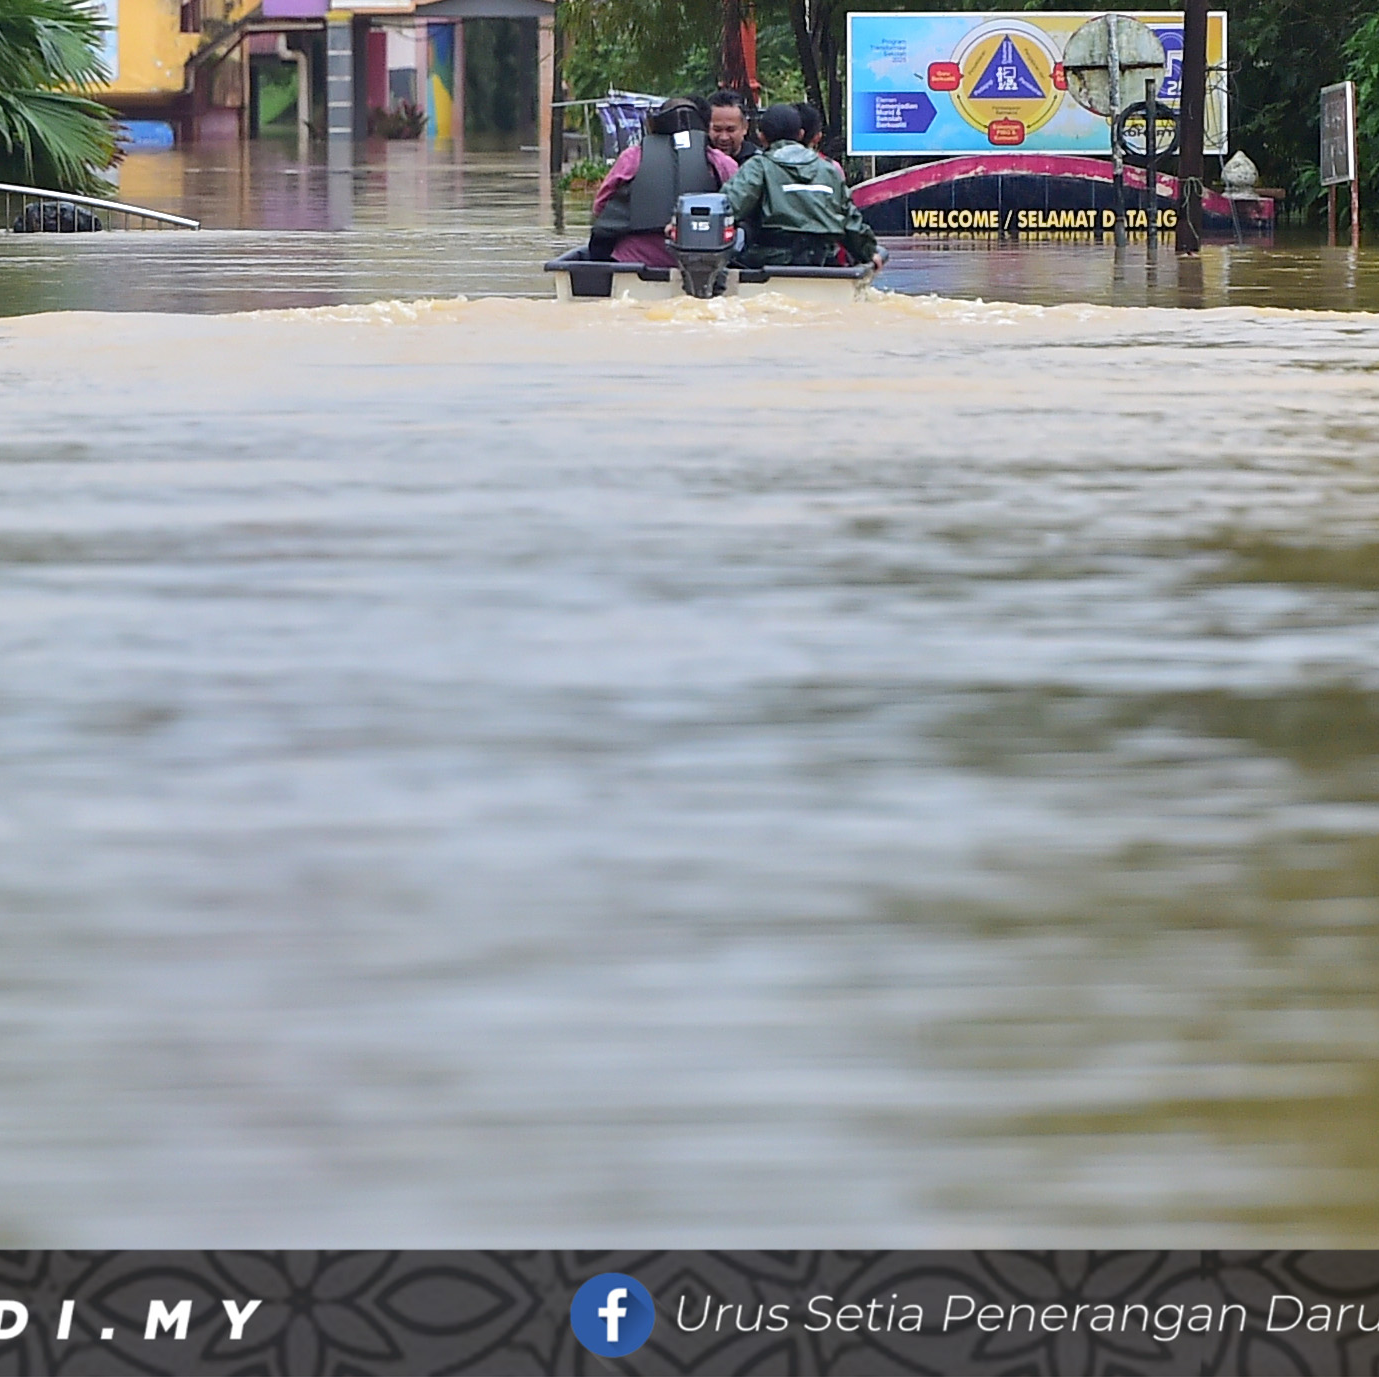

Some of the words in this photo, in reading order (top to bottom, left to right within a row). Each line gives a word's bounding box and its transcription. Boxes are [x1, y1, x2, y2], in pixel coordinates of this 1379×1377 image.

[691, 221, 711, 231] 15
[910, 209, 999, 229] WELCOME
[1003, 209, 1013, 230] /
[1017, 209, 1098, 229] SELAMAT
[1102, 209, 1178, 229] DTAG
